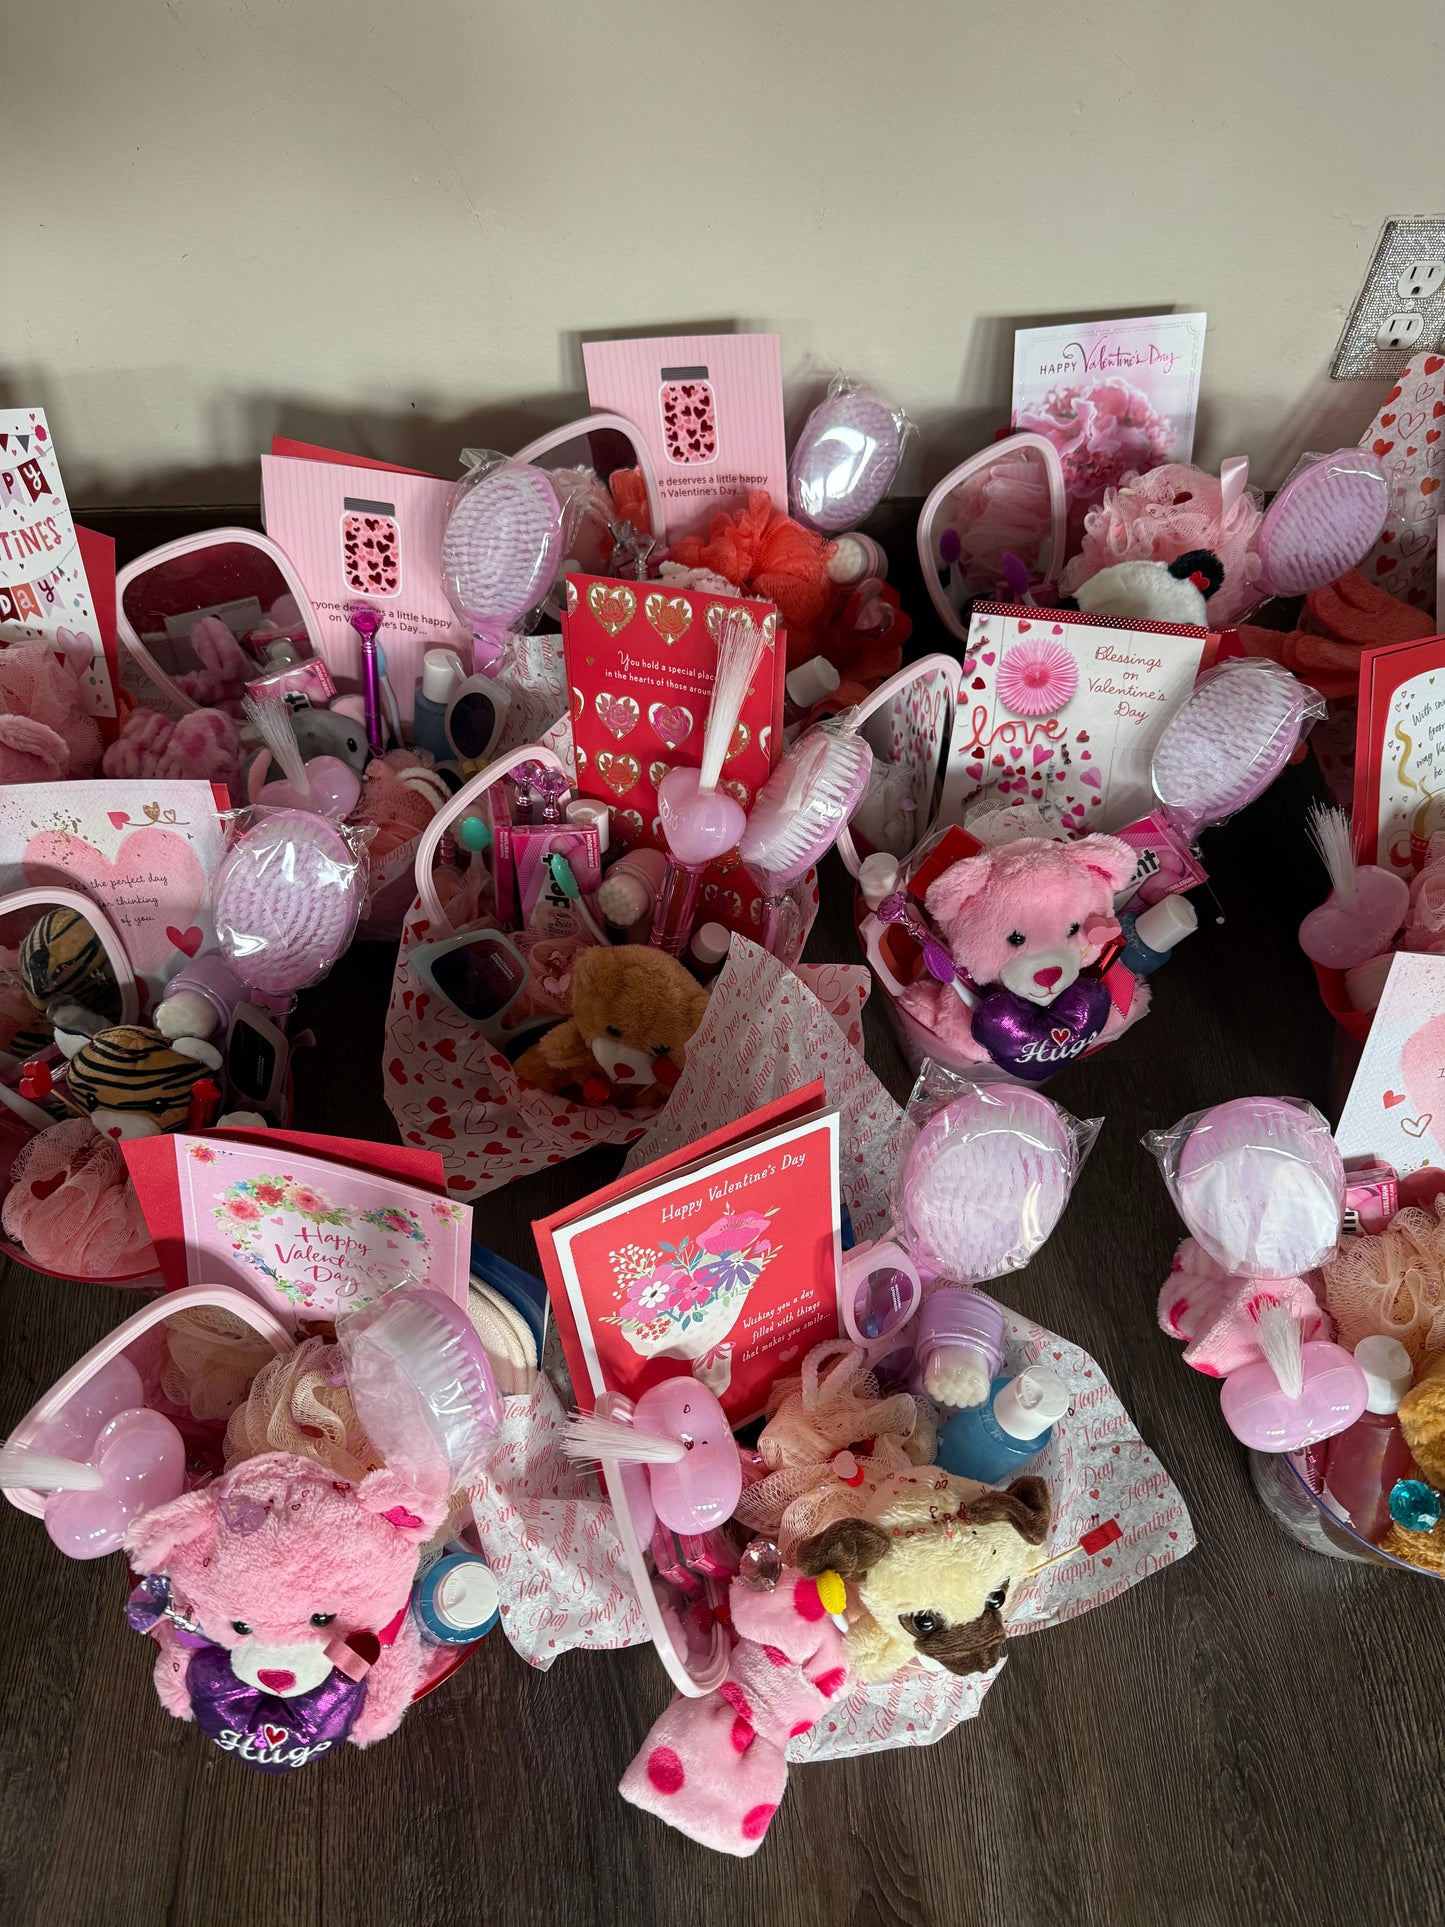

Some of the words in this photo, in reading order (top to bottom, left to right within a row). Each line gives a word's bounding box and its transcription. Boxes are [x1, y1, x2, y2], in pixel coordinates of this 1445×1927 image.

[1040, 362, 1078, 375] HAPPY
[1062, 336, 1149, 374] Valentine's
[1148, 344, 1181, 374] Day
[666, 476, 707, 486] deserves
[716, 474, 737, 484] little
[738, 474, 768, 485] happy
[667, 487, 718, 498] Valentine's
[312, 601, 340, 612] ryone
[397, 610, 419, 622] little
[421, 614, 452, 629] happy
[329, 613, 342, 623] on
[618, 650, 640, 671] You
[642, 659, 659, 670] hold
[669, 665, 696, 677] special
[1094, 645, 1164, 674] Blessings
[605, 669, 613, 677] in
[614, 671, 627, 680] the
[629, 673, 654, 685] hearts
[656, 678, 664, 686] of
[666, 679, 688, 691] those
[689, 685, 712, 696] aroun
[1088, 677, 1168, 702] Valentine's
[1122, 671, 1139, 681] on
[1113, 700, 1150, 725] Day
[957, 705, 1068, 753] love
[91, 879, 108, 888] the
[110, 875, 145, 890] perfect
[148, 873, 168, 886] day
[116, 895, 159, 907] thinking
[121, 914, 131, 927] of
[771, 1012, 793, 1054] Day
[660, 1198, 704, 1224] Happy
[708, 1164, 777, 1202] Valentine's
[780, 1151, 806, 1173] Day
[295, 1226, 372, 1257] Happy
[275, 1243, 387, 1280] Valentine's
[304, 1265, 361, 1298] Day
[743, 1309, 775, 1329] Wishing
[777, 1301, 791, 1315] you
[800, 1289, 814, 1300] day
[751, 1321, 774, 1345] filled
[777, 1312, 794, 1328] with
[796, 1301, 821, 1318] things
[742, 1346, 759, 1362] that
[761, 1335, 785, 1352] makes
[787, 1327, 801, 1341] you
[1078, 1461, 1114, 1494] Day
[1044, 1557, 1096, 1593] Happy
[529, 1606, 569, 1633] Day
